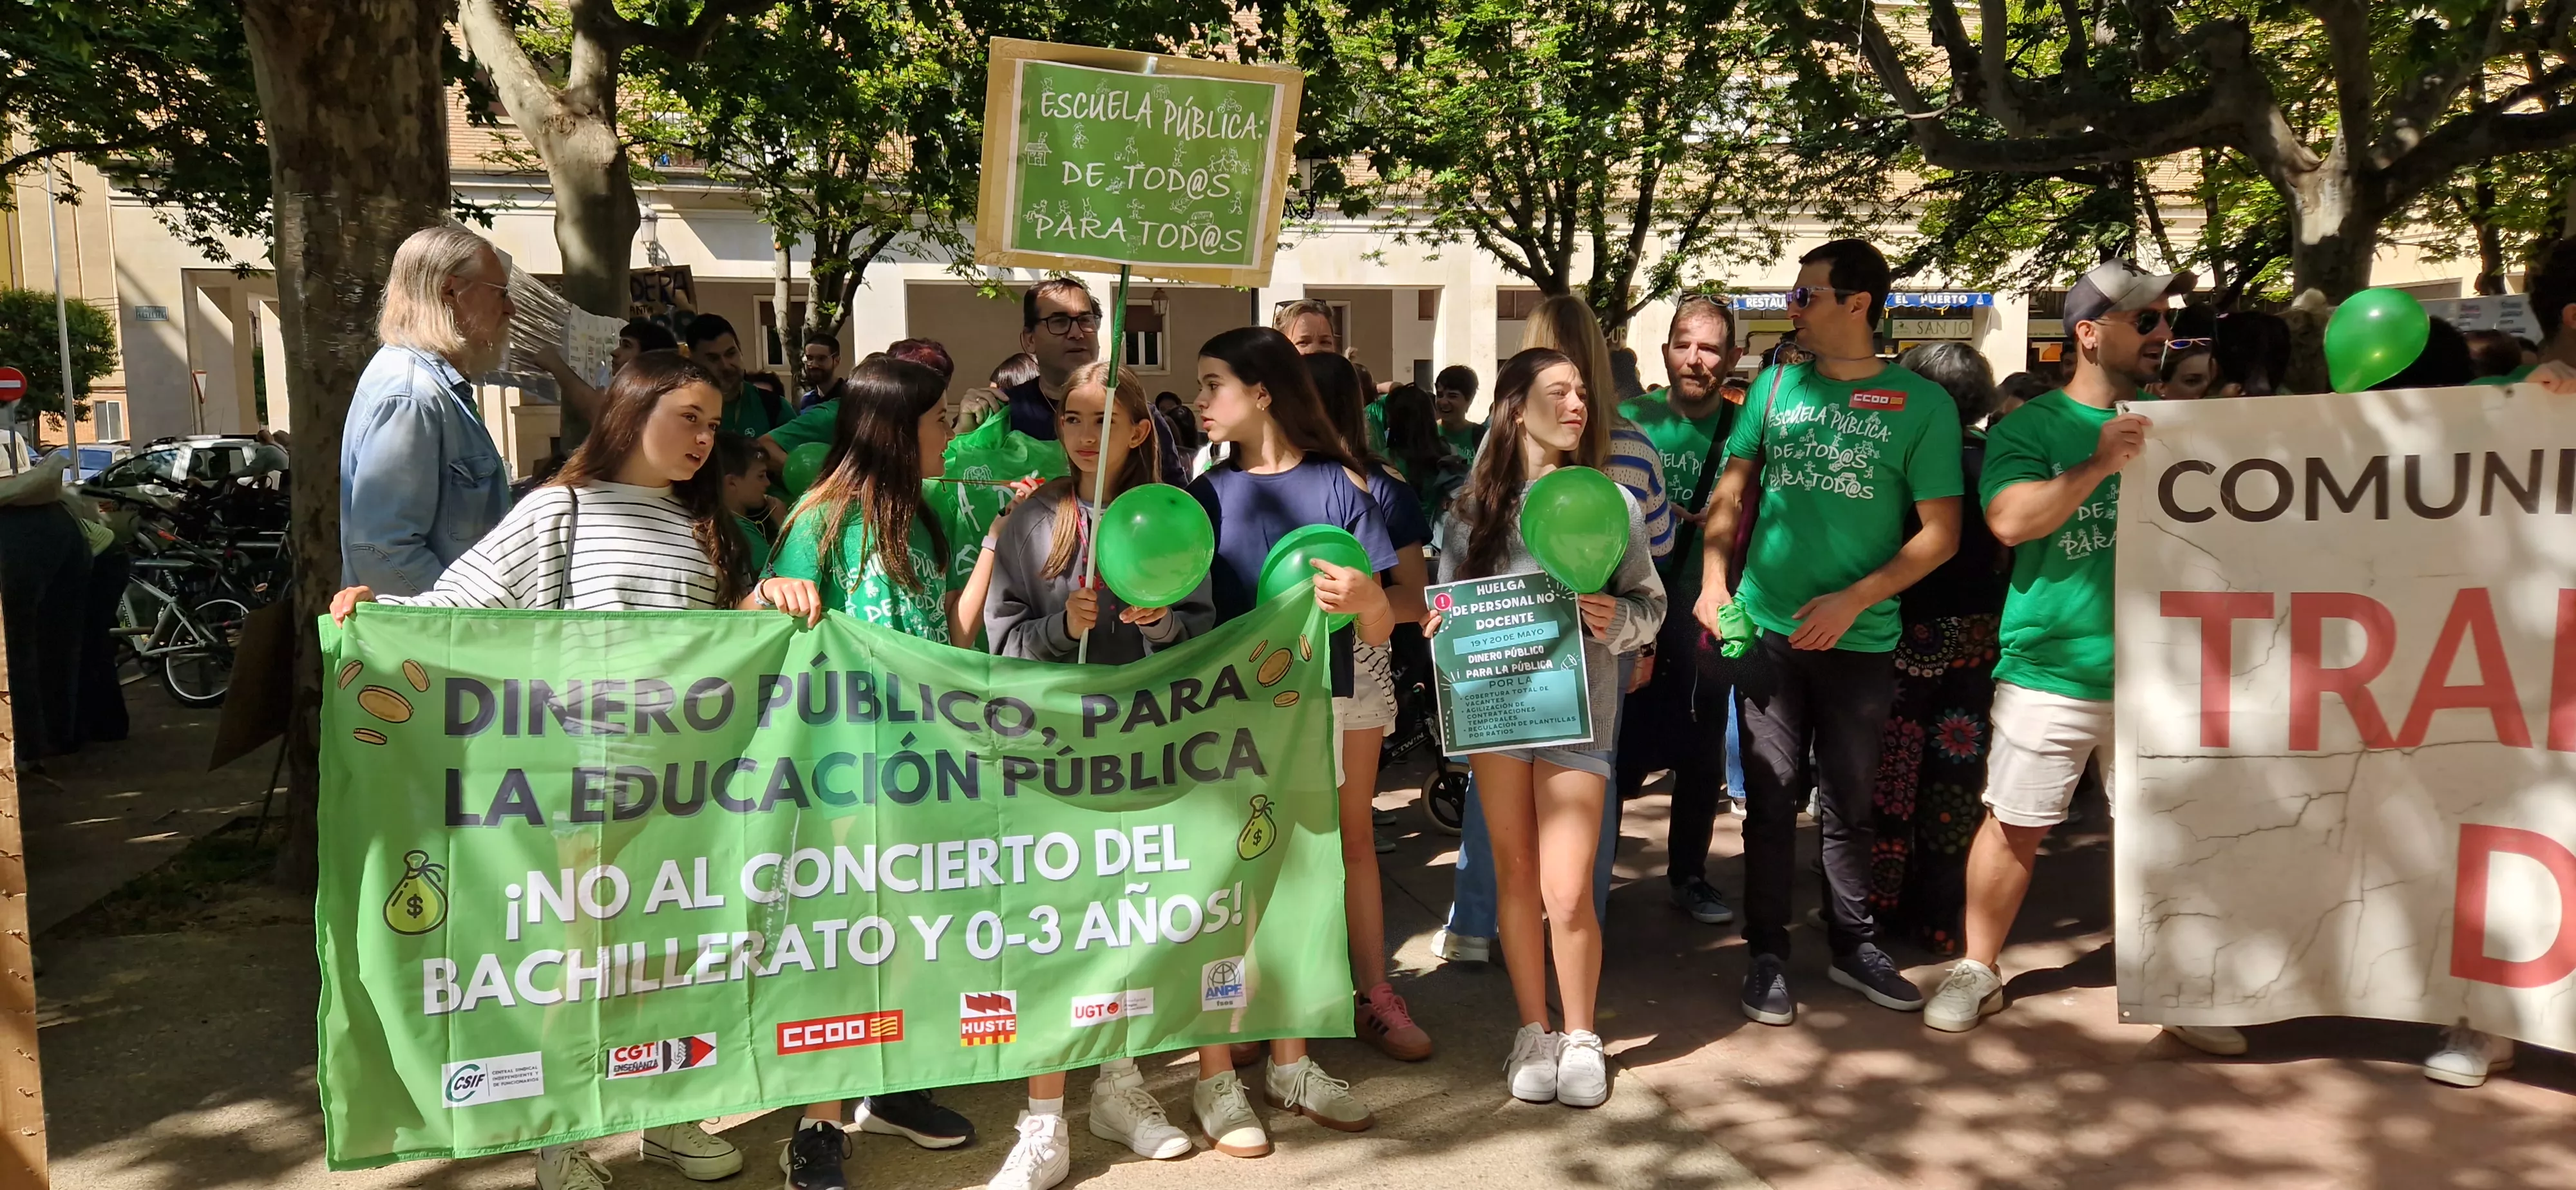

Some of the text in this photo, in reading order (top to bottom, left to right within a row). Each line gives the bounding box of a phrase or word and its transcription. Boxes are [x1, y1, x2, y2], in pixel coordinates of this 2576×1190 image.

[1041, 90, 1264, 140] ESCUELA PÚBLICA:
[1063, 160, 1230, 198] DE TOD@S
[1036, 214, 1243, 254] PARA TOD@S
[1895, 295, 1908, 304] EL
[1920, 295, 1967, 304] PUERTO
[1917, 321, 1946, 334] SAN
[1854, 393, 1889, 404] CCOO
[1768, 404, 1891, 442] ESCUELA PÚBLICA:
[1774, 443, 1868, 469] DE TOD@S
[1768, 471, 1874, 499] PARA TOD@S
[2078, 502, 2104, 521] DE
[1477, 579, 1526, 596] HUELGA
[864, 599, 891, 623] DE
[1452, 592, 1555, 617] DE PERSONAL NO
[1475, 612, 1535, 630] DOCENTE
[1517, 628, 1544, 639] MAYO
[1468, 645, 1544, 663] DINERO PÚBLICO
[1466, 659, 1553, 679] PARA LA PÚBLICA
[1489, 676, 1532, 688] POR LA
[444, 652, 1249, 746] DINERO PÚBLICO, PARA
[1464, 690, 1510, 700] COBERTURA
[1465, 697, 1505, 707] VACANTES
[1466, 703, 1513, 713] AGILIZACIÓN
[1467, 706, 1536, 719] CONTRATACIONES
[1468, 715, 1518, 726] TEMPORALES
[1468, 721, 1516, 732] REGULACIÓN
[1530, 716, 1577, 725] PLANTILLAS
[445, 727, 1267, 827] LA EDUCACIÓN PÚBLICA
[505, 823, 1191, 941] ¡NO AL CONCIERTO DEL
[422, 882, 1244, 1015] BACHILLERATO Y 0-3 AÑOS!
[1206, 984, 1243, 998] ANPE
[1075, 1004, 1104, 1019] UGT
[783, 1019, 865, 1048] CCOO
[961, 1019, 1016, 1034] HUSTE
[614, 1043, 655, 1062] CGT
[613, 1059, 659, 1072] ENSEÑANZA
[454, 1073, 485, 1091] CSIF
[501, 1077, 539, 1086] FUNCIONARIOS
